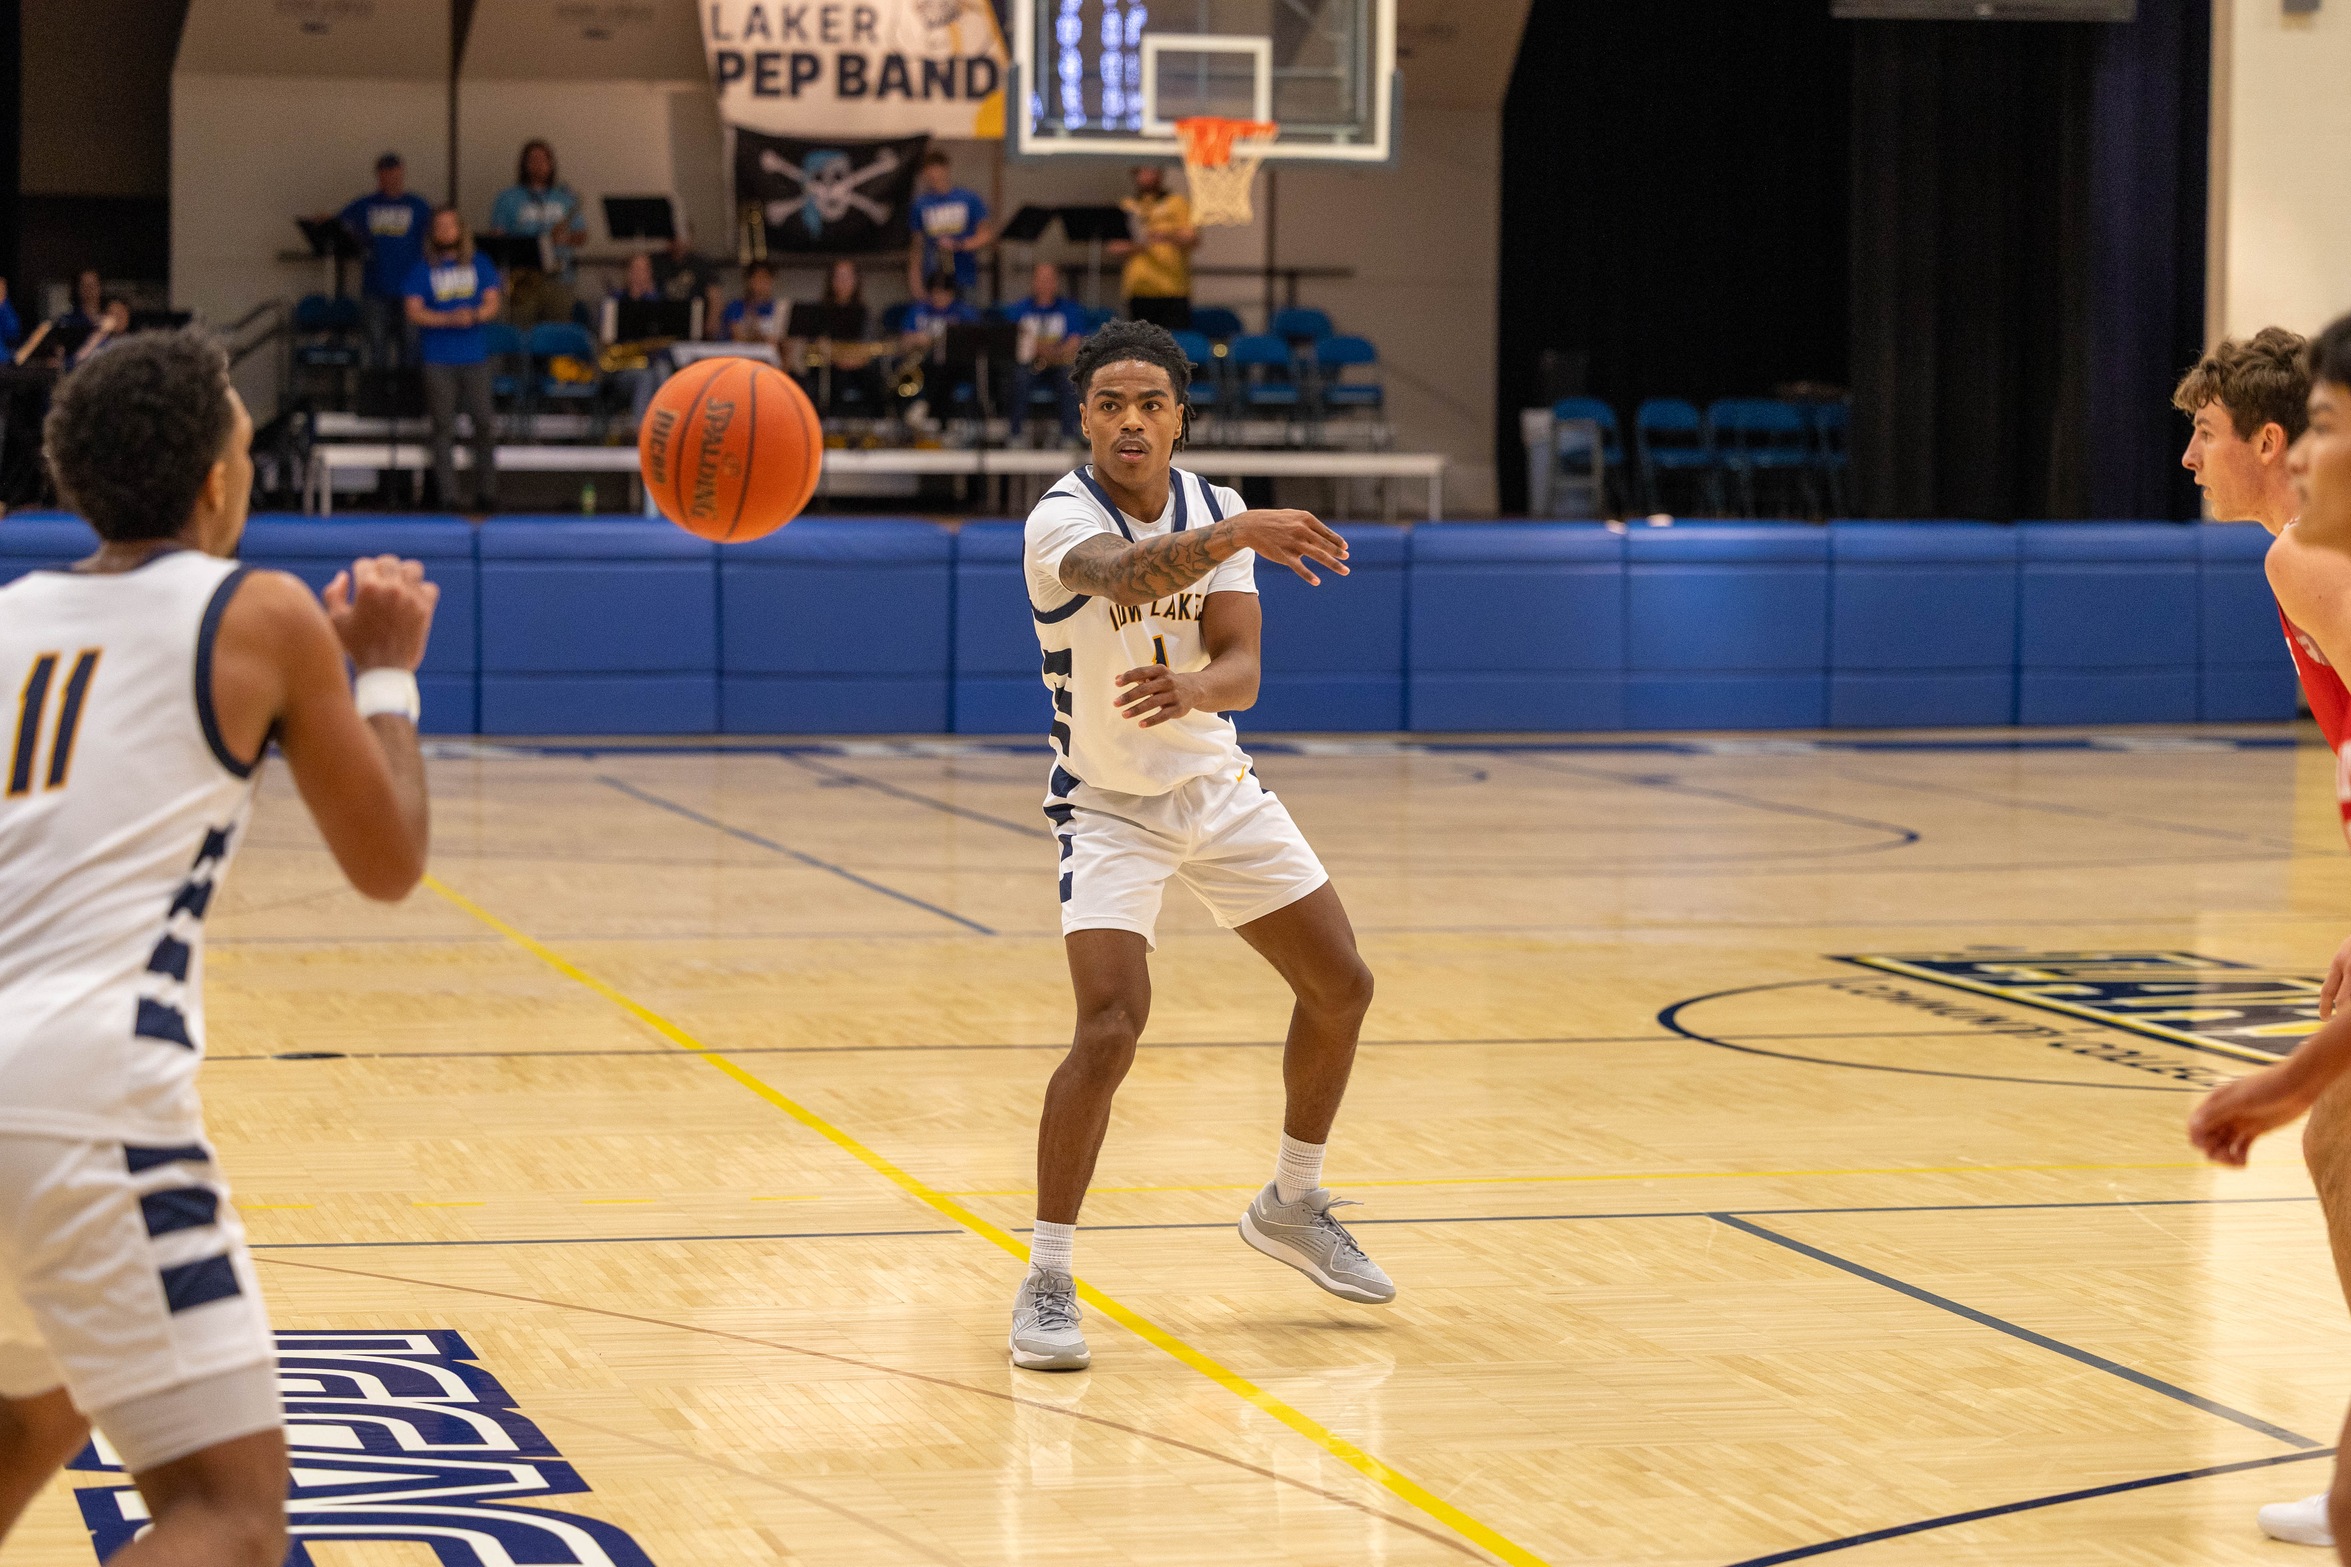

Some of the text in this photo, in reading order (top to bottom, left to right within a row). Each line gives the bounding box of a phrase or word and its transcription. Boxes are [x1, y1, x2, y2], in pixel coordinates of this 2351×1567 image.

[709, 3, 879, 43] LAKER
[716, 51, 1000, 99] PEP BAND
[690, 397, 736, 520] SPALDING
[1150, 591, 1204, 622] LAKE
[5, 645, 105, 799] 11
